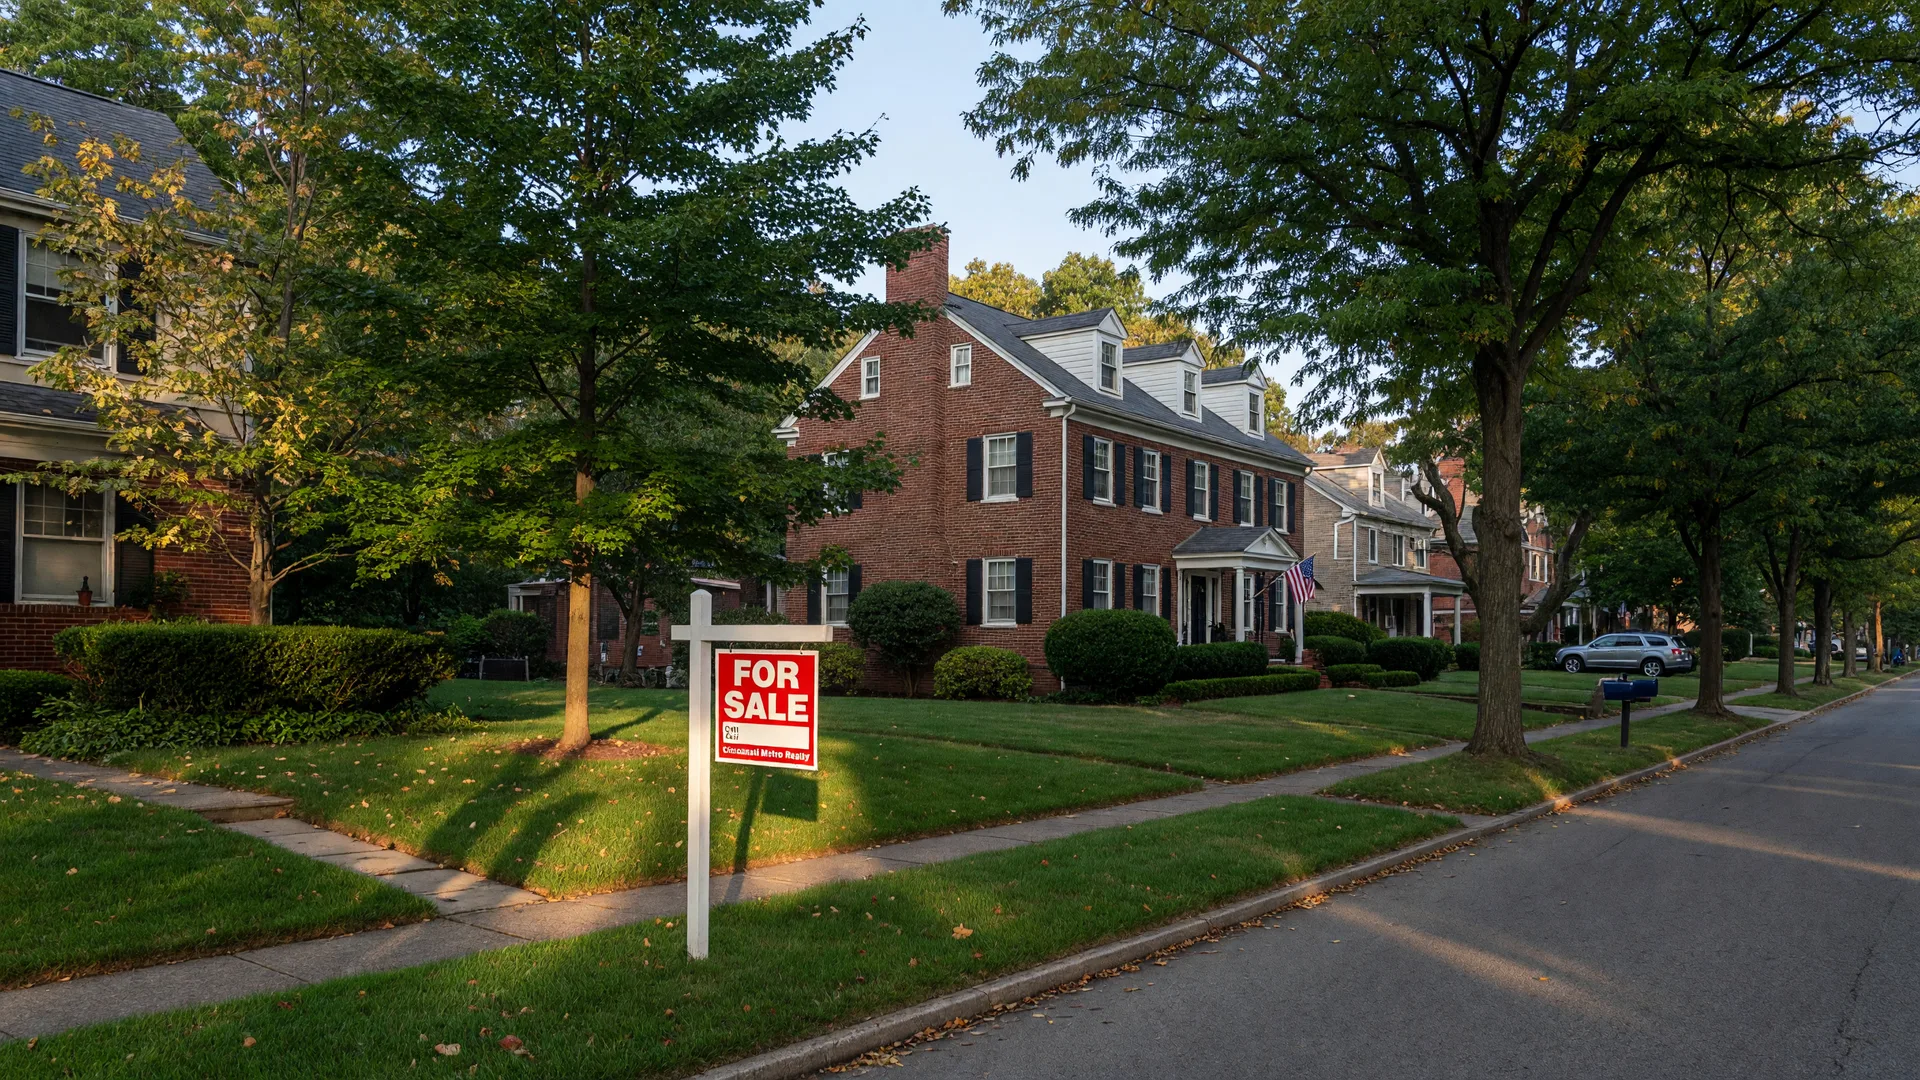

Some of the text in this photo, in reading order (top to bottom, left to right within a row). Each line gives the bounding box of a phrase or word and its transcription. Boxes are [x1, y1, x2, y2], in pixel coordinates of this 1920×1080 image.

[734, 659, 799, 689] FOR
[724, 690, 809, 722] SALE
[761, 748, 784, 759] Metro
